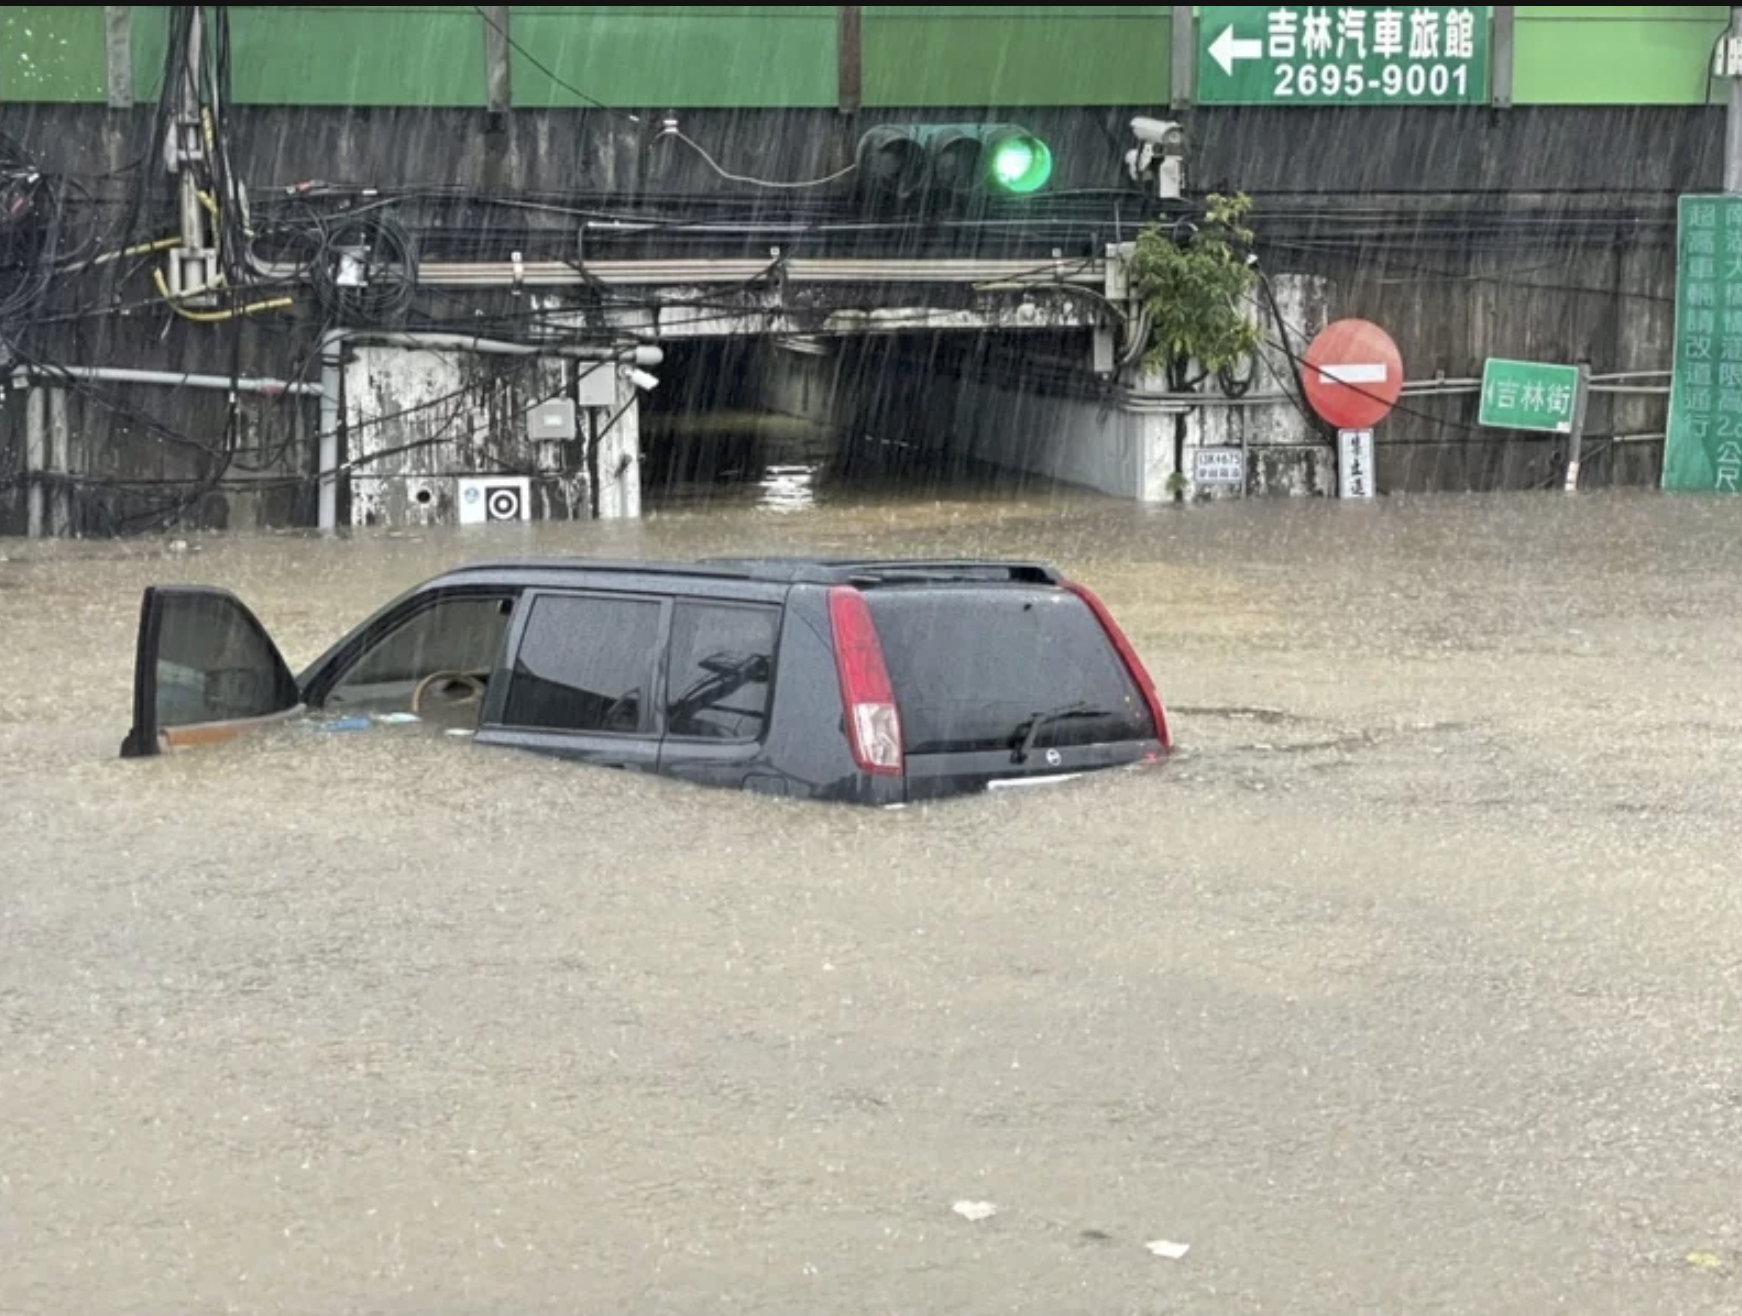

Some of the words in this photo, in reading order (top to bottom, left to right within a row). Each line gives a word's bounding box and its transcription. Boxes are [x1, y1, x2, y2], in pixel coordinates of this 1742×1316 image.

[1267, 8, 1474, 59] 吉林汽車旅館
[1273, 64, 1468, 96] 2695-9001
[1497, 377, 1571, 415] 吉林街
